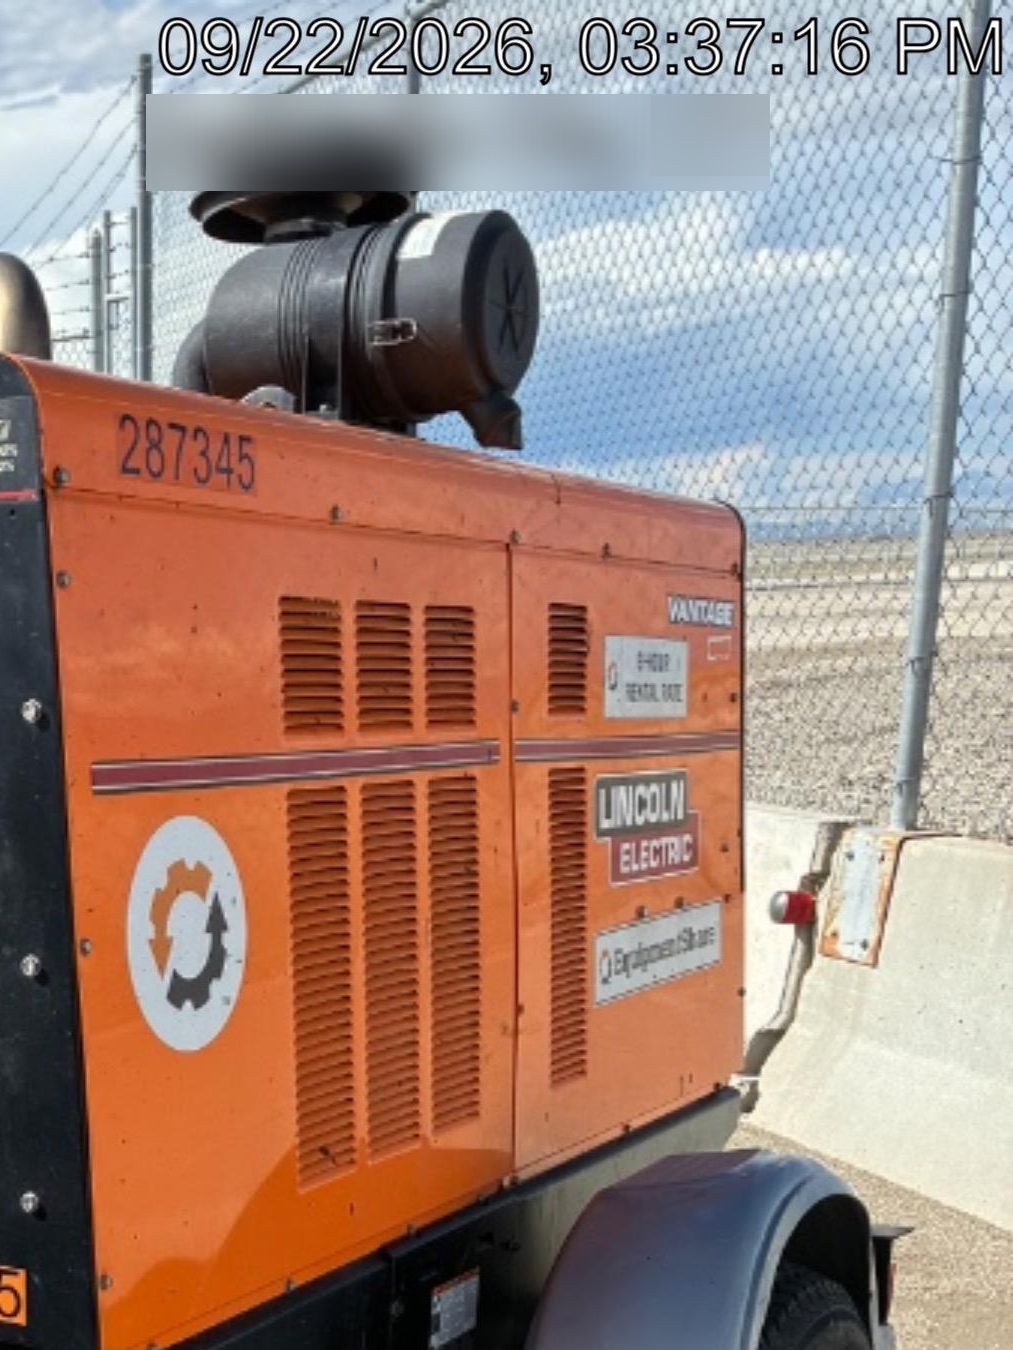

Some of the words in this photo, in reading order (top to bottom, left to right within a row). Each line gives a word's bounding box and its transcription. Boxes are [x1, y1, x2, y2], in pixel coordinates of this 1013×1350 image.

[119, 413, 255, 492] 287345
[668, 597, 734, 626] VANTAGE
[599, 780, 685, 829] LINCOLN
[619, 833, 693, 874] ELECTRIC
